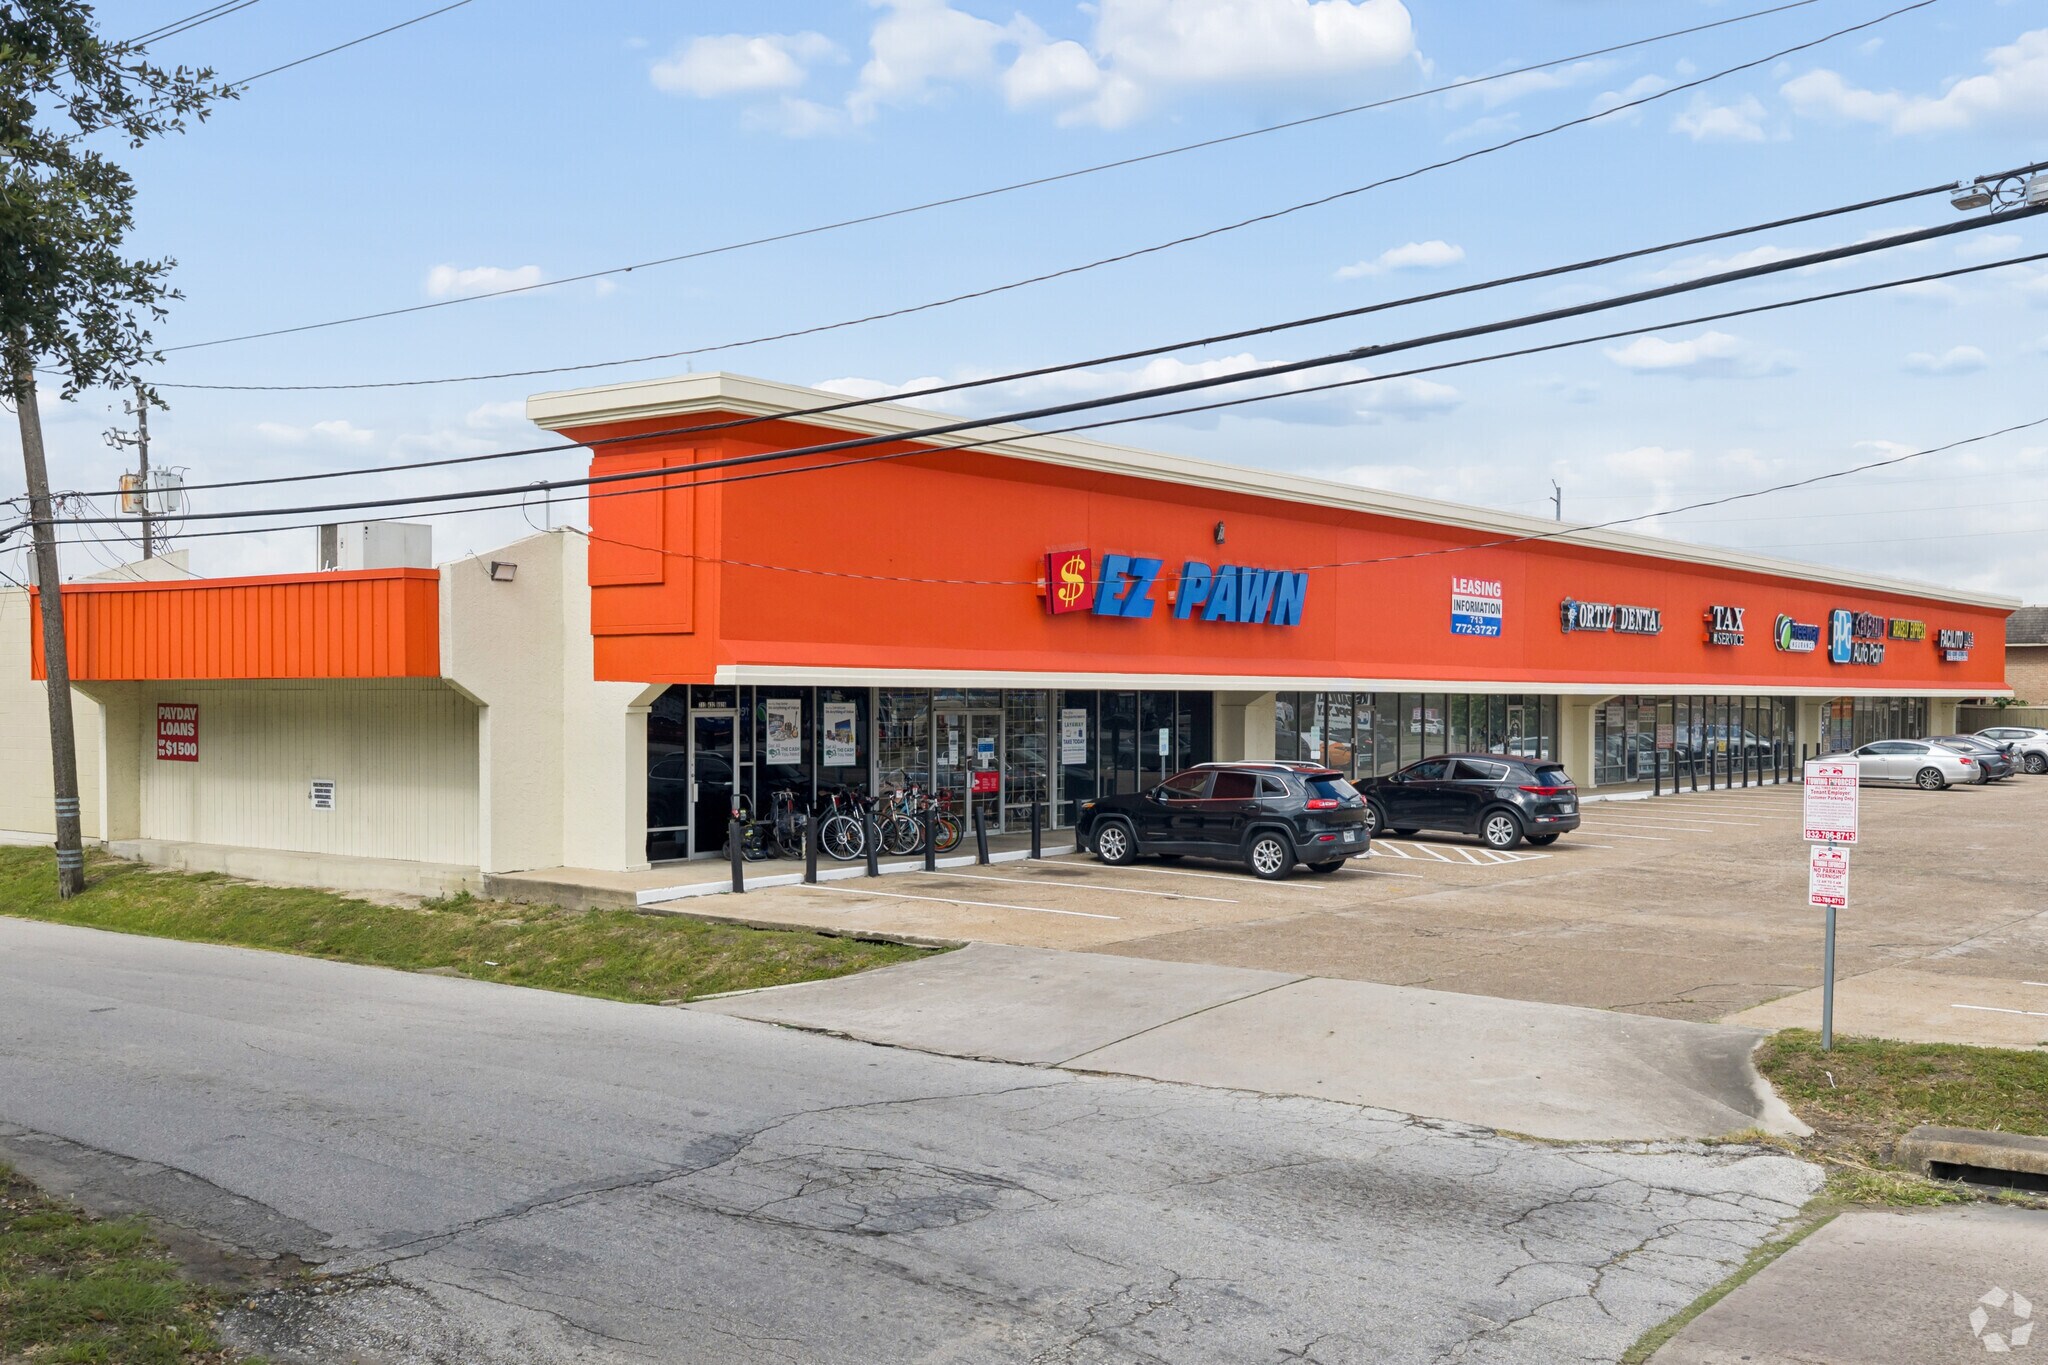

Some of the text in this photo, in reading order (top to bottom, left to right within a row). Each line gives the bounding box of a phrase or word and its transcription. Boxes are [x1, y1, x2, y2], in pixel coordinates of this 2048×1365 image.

[1092, 553, 1164, 619] EZ
[1173, 561, 1309, 627] PAWN
[1453, 577, 1501, 597] LEASING
[1453, 599, 1501, 615] INFORMATION
[1469, 616, 1484, 624] 713
[1579, 604, 1615, 629] ORTIZ
[1713, 605, 1745, 632] TAX
[1455, 623, 1498, 635] 772-3727
[1717, 633, 1745, 646] SERVICE
[1853, 642, 1868, 662] Auto
[158, 706, 197, 720] PAYDAY
[160, 721, 195, 736] LOANS
[165, 740, 197, 756] $1500
[1807, 777, 1855, 787] TOWING ENFORCED
[1806, 830, 1855, 841] 832-786-8713
